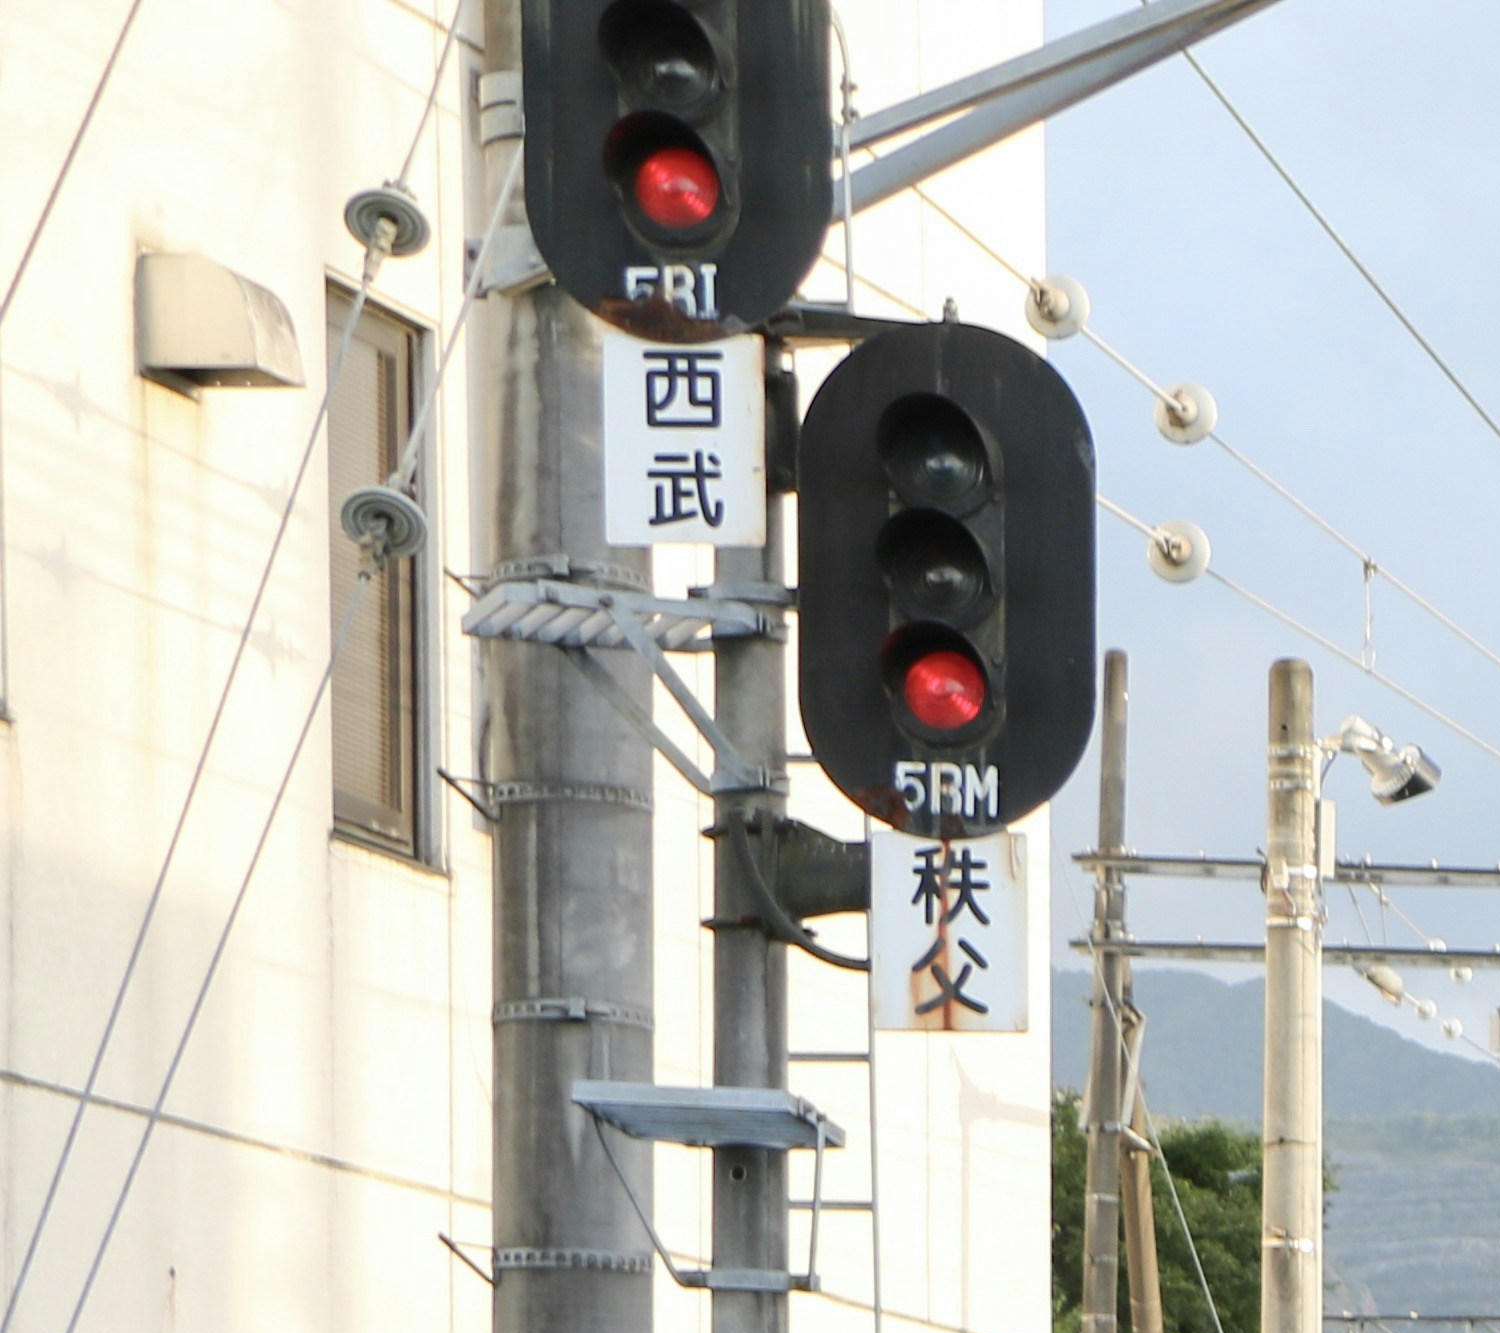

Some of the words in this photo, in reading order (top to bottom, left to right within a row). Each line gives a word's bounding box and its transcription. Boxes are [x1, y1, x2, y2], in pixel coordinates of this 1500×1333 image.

[643, 351, 723, 527] 西武
[894, 760, 999, 818] 5RM
[911, 846, 991, 1015] 秩父
